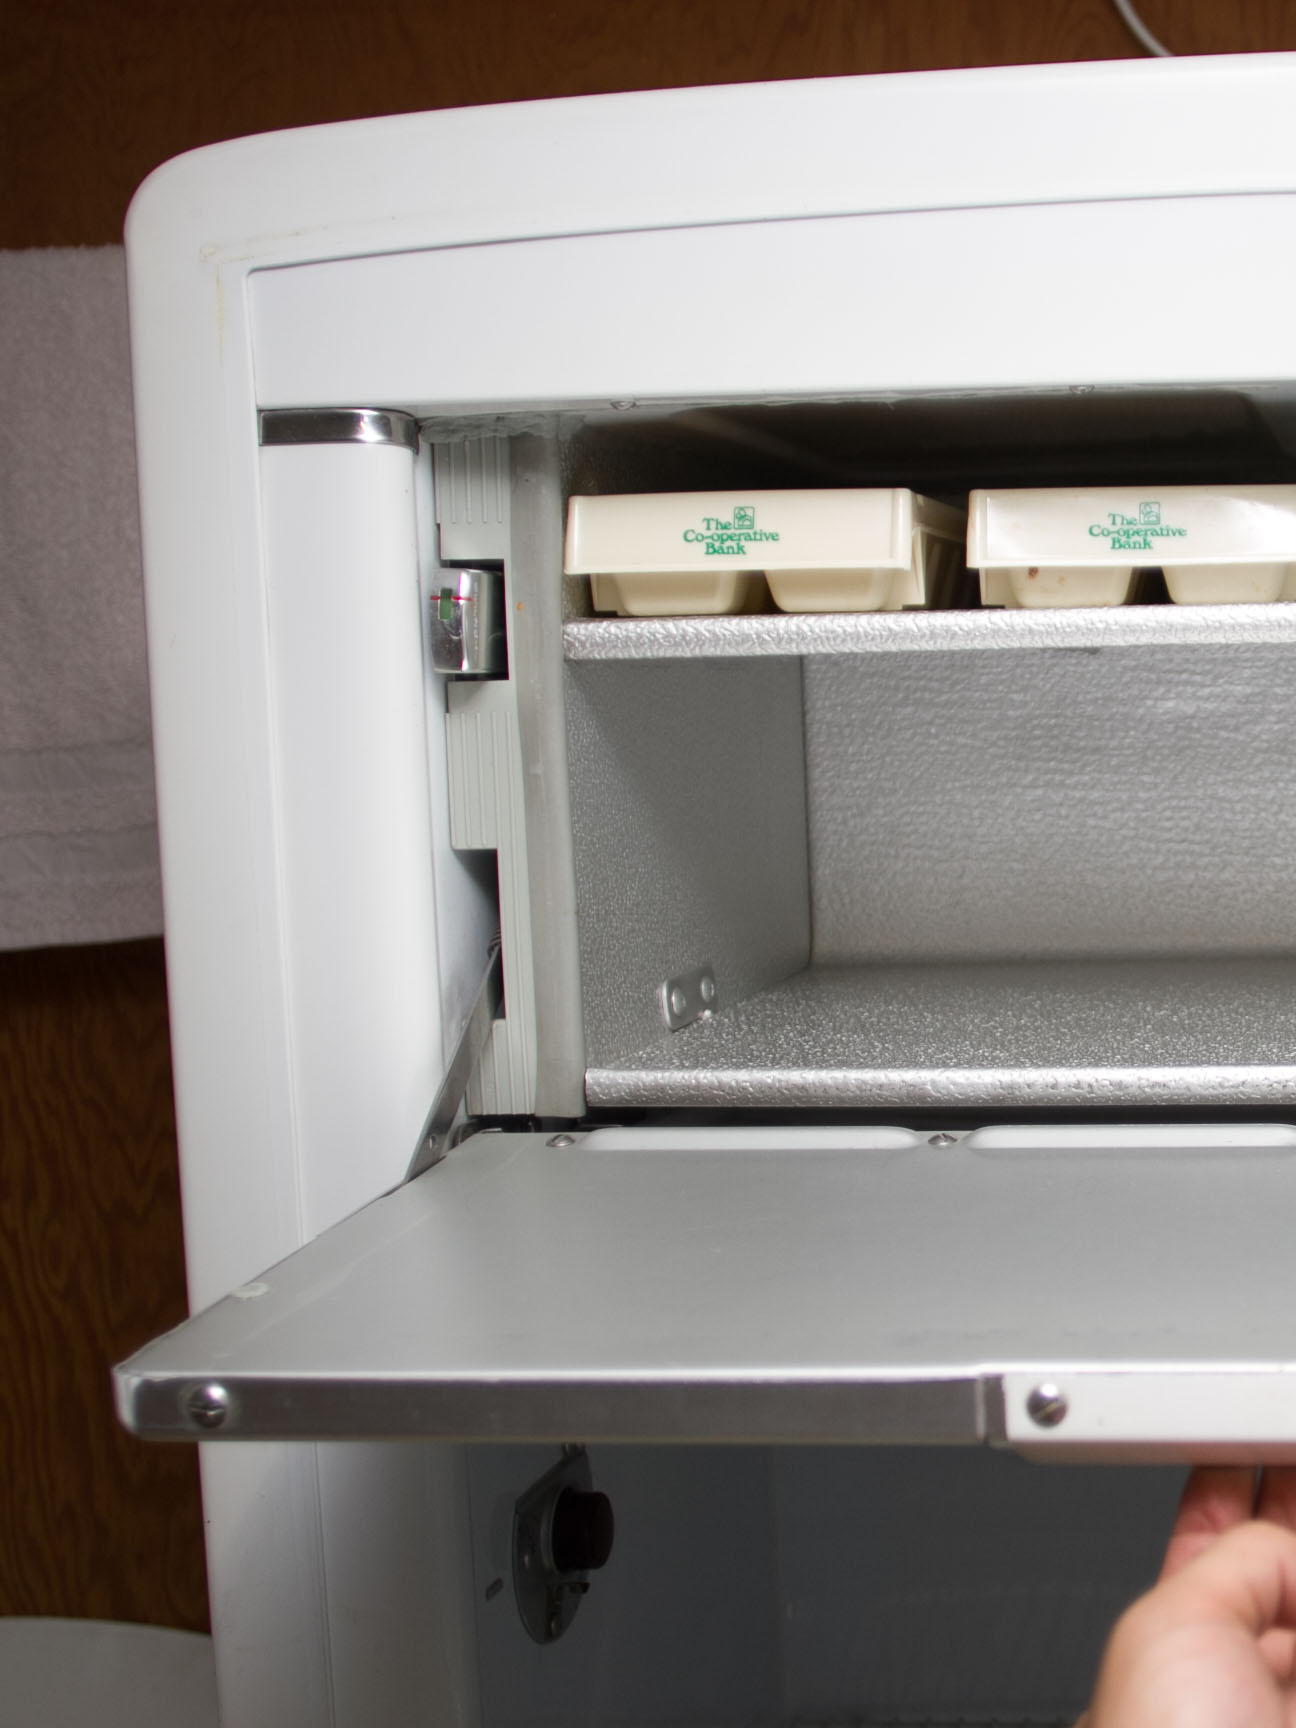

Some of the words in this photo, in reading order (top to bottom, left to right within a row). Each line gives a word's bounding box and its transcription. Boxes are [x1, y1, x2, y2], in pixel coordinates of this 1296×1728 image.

[703, 518, 732, 530] The
[1108, 513, 1138, 525] The
[683, 529, 780, 543] Co-operative
[1088, 524, 1187, 538] Co-operative
[705, 542, 746, 555] Bank
[1110, 537, 1153, 550] Bank
